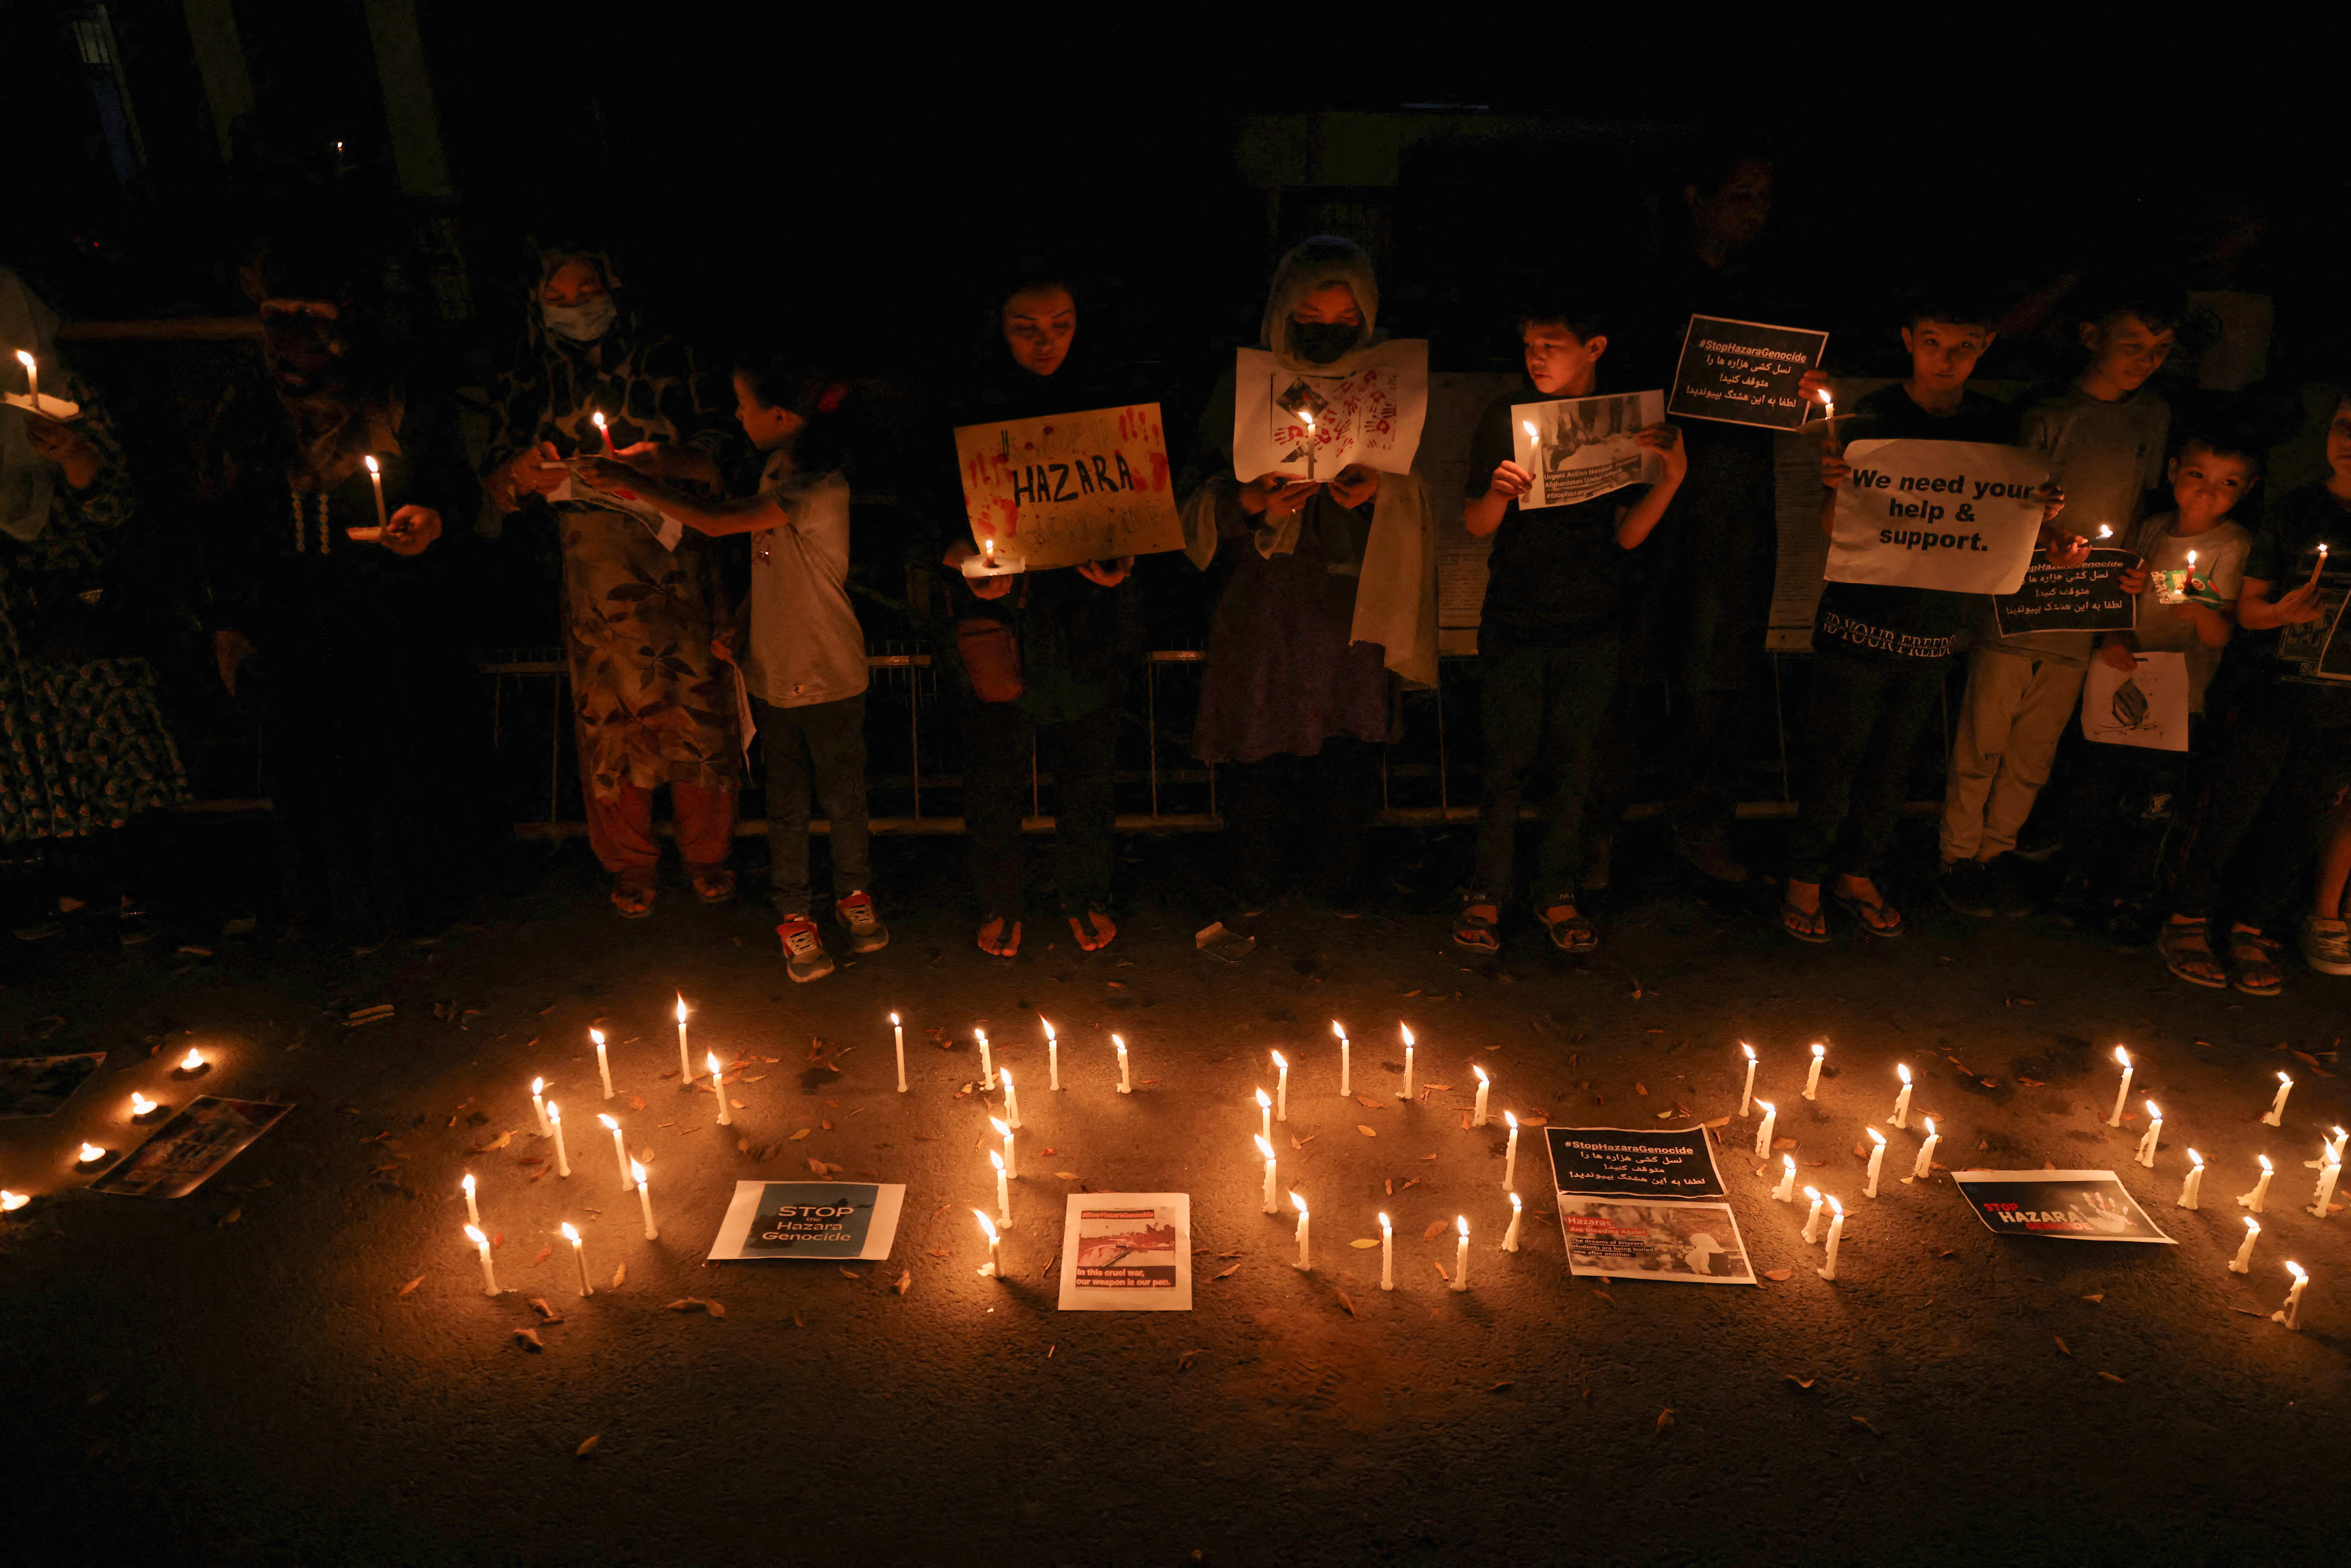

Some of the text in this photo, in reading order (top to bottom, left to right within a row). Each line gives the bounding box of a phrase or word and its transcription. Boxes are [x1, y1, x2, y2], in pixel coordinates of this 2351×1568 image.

[1699, 339, 1807, 363] #StopHazaraGenocide
[1706, 354, 1791, 375] نسل کشی هزاره ها را
[1742, 376, 1769, 388] متوقف
[1751, 395, 1765, 405] این
[1779, 397, 1797, 407] لطفا
[1012, 454, 1134, 507] HAZARA
[1545, 479, 1583, 488] Afghanistan
[1853, 469, 2035, 500] We need your
[1889, 498, 1975, 523] help &
[1879, 529, 1988, 551] support.
[2040, 574, 2062, 583] هزاره
[2090, 570, 2108, 581] نسل
[2074, 601, 2089, 612] این
[2092, 603, 2101, 611] به
[2104, 600, 2122, 609] لطفا
[1842, 619, 1895, 651] YOUR
[1565, 1141, 1694, 1155] #StopHazaraGenocide
[1606, 1154, 1632, 1162] هزاره
[778, 1206, 855, 1217] STOP
[1984, 1203, 2019, 1211] STOP
[1568, 1217, 1611, 1226] Hazaras
[1998, 1211, 2083, 1223] HAZARA
[777, 1222, 842, 1230] Hazara
[762, 1232, 851, 1241] Genocide
[1152, 1279, 1171, 1287] pen.
